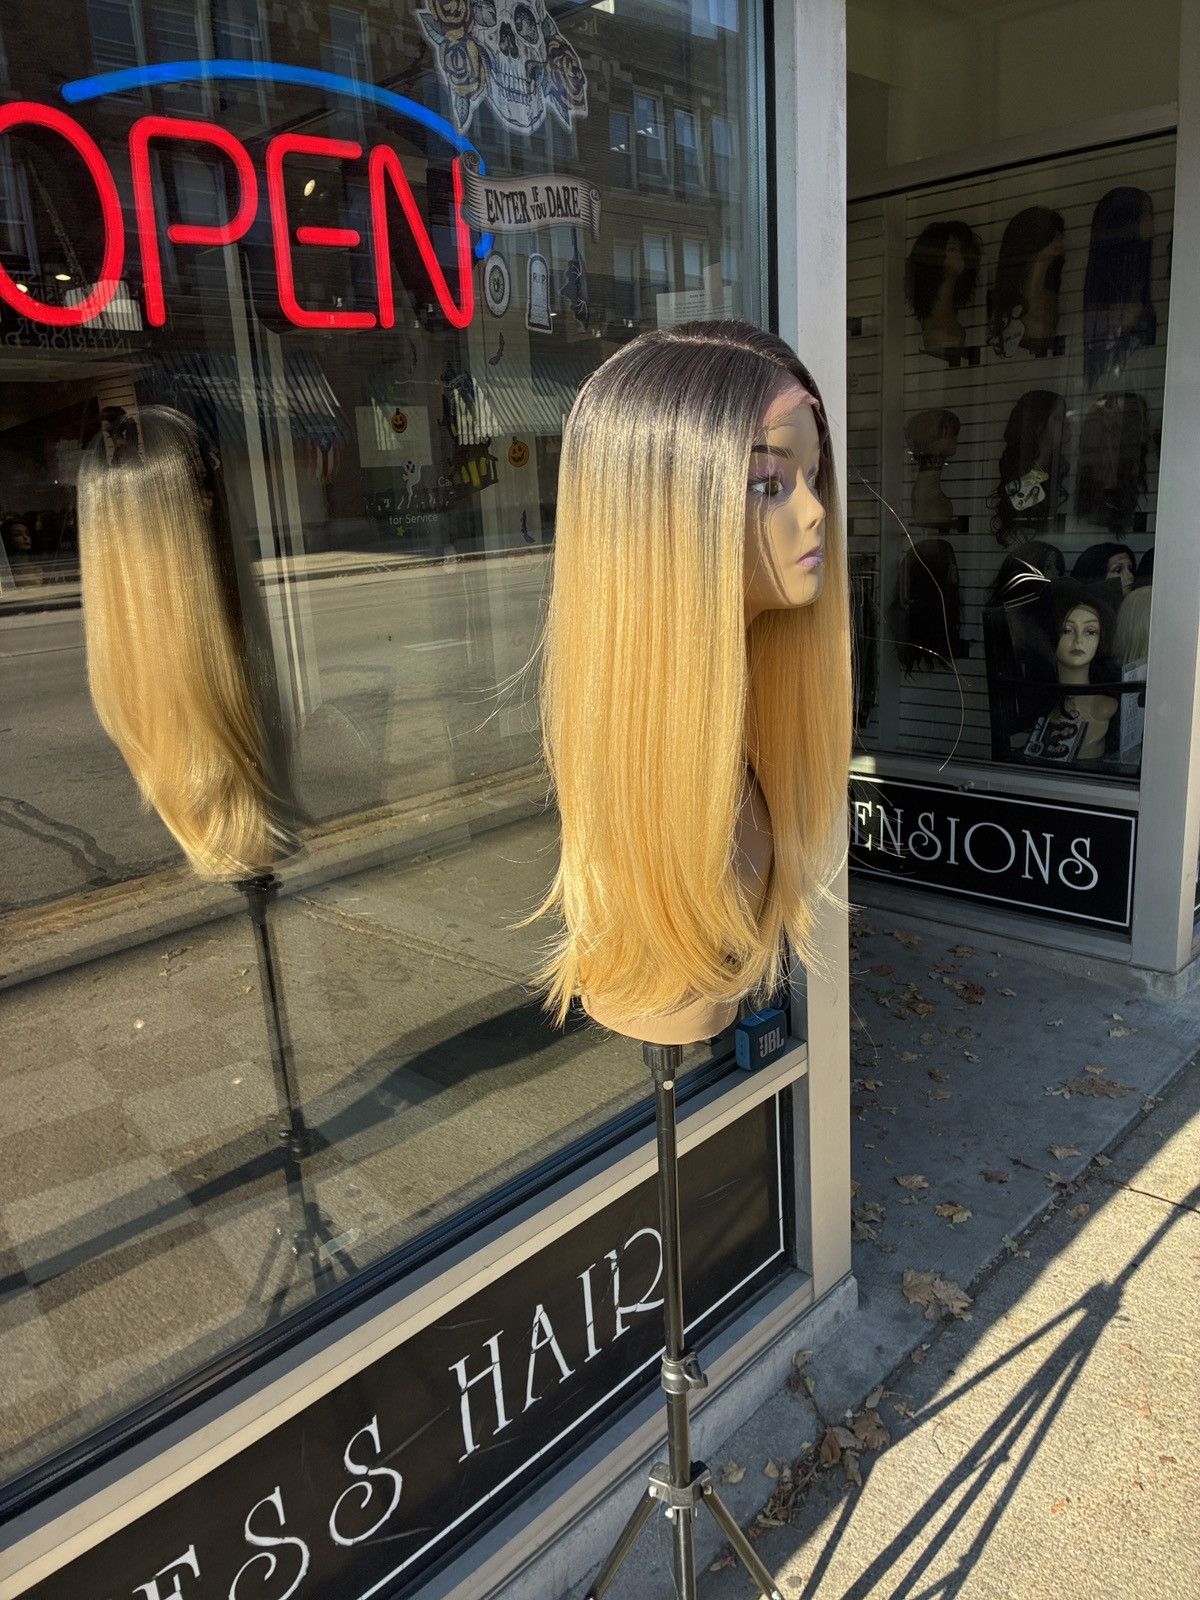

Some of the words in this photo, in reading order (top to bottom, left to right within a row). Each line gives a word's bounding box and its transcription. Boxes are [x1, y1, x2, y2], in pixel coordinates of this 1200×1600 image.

[484, 188, 531, 225] ENTER
[531, 186, 539, 202] IF
[545, 186, 580, 218] DARE
[0, 101, 474, 329] OPEN
[530, 202, 546, 220] YOU
[405, 513, 438, 525] Service
[851, 800, 1098, 891] ENSIONS
[758, 1026, 784, 1058] JBL
[448, 1227, 664, 1462] HAIR
